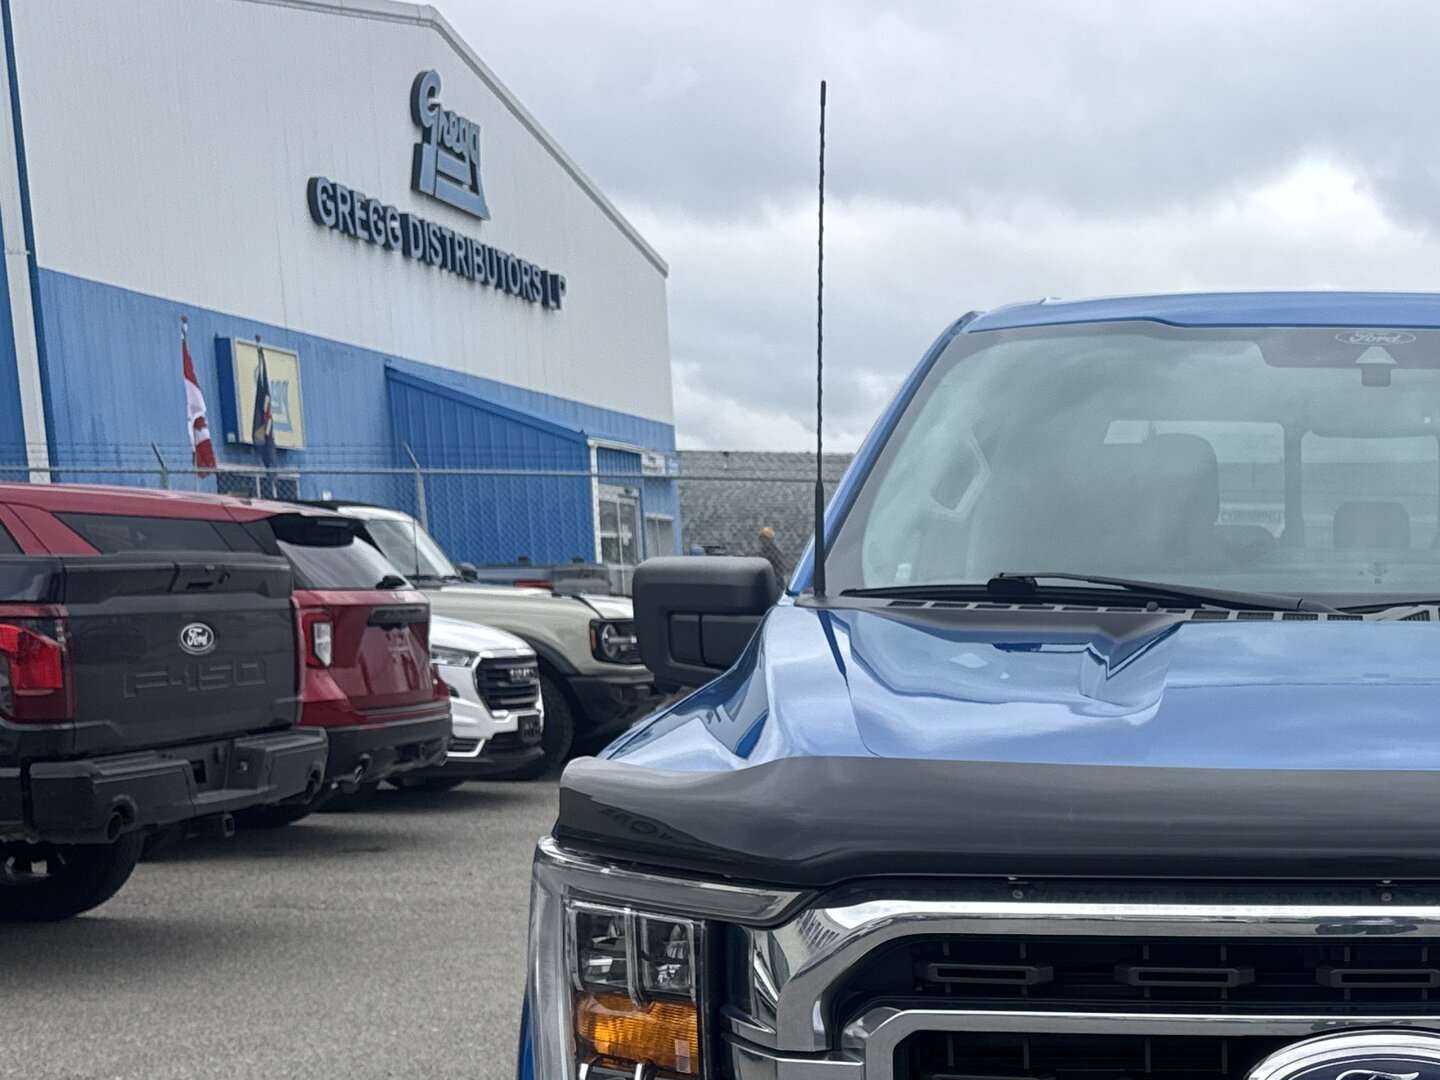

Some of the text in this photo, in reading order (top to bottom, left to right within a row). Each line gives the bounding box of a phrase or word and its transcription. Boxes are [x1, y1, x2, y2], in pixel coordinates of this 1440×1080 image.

[307, 177, 567, 310] GREGG DISTRIBUTORS LP
[1350, 329, 1400, 345] Ford
[187, 628, 208, 646] Ford
